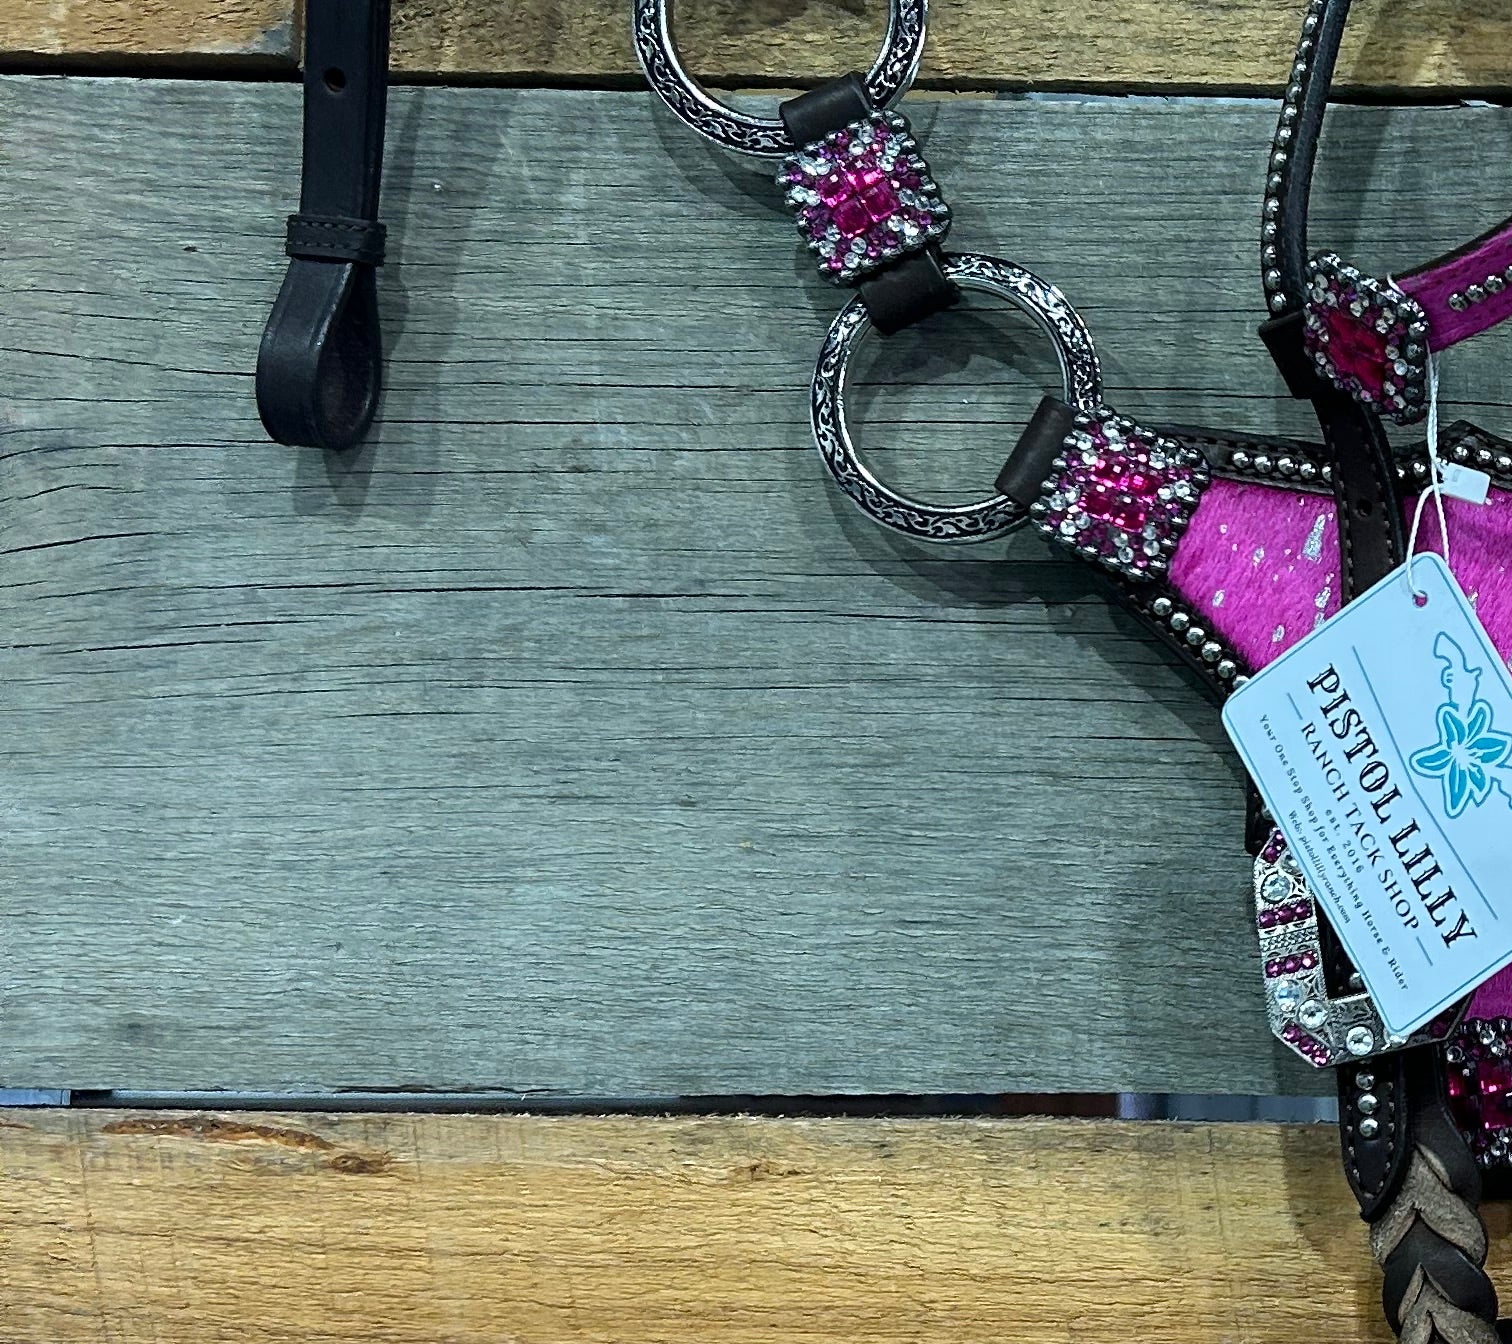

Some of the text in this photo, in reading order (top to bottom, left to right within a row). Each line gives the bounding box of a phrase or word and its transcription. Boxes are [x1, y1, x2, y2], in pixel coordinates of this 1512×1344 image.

[1259, 713, 1409, 991] Your One Stop Shop for Everything Horse & Rider
[1300, 720, 1420, 930] RANCH TACK SHOP
[1304, 662, 1479, 951] PISTOL LILLY
[1324, 808, 1365, 874] est. 2016
